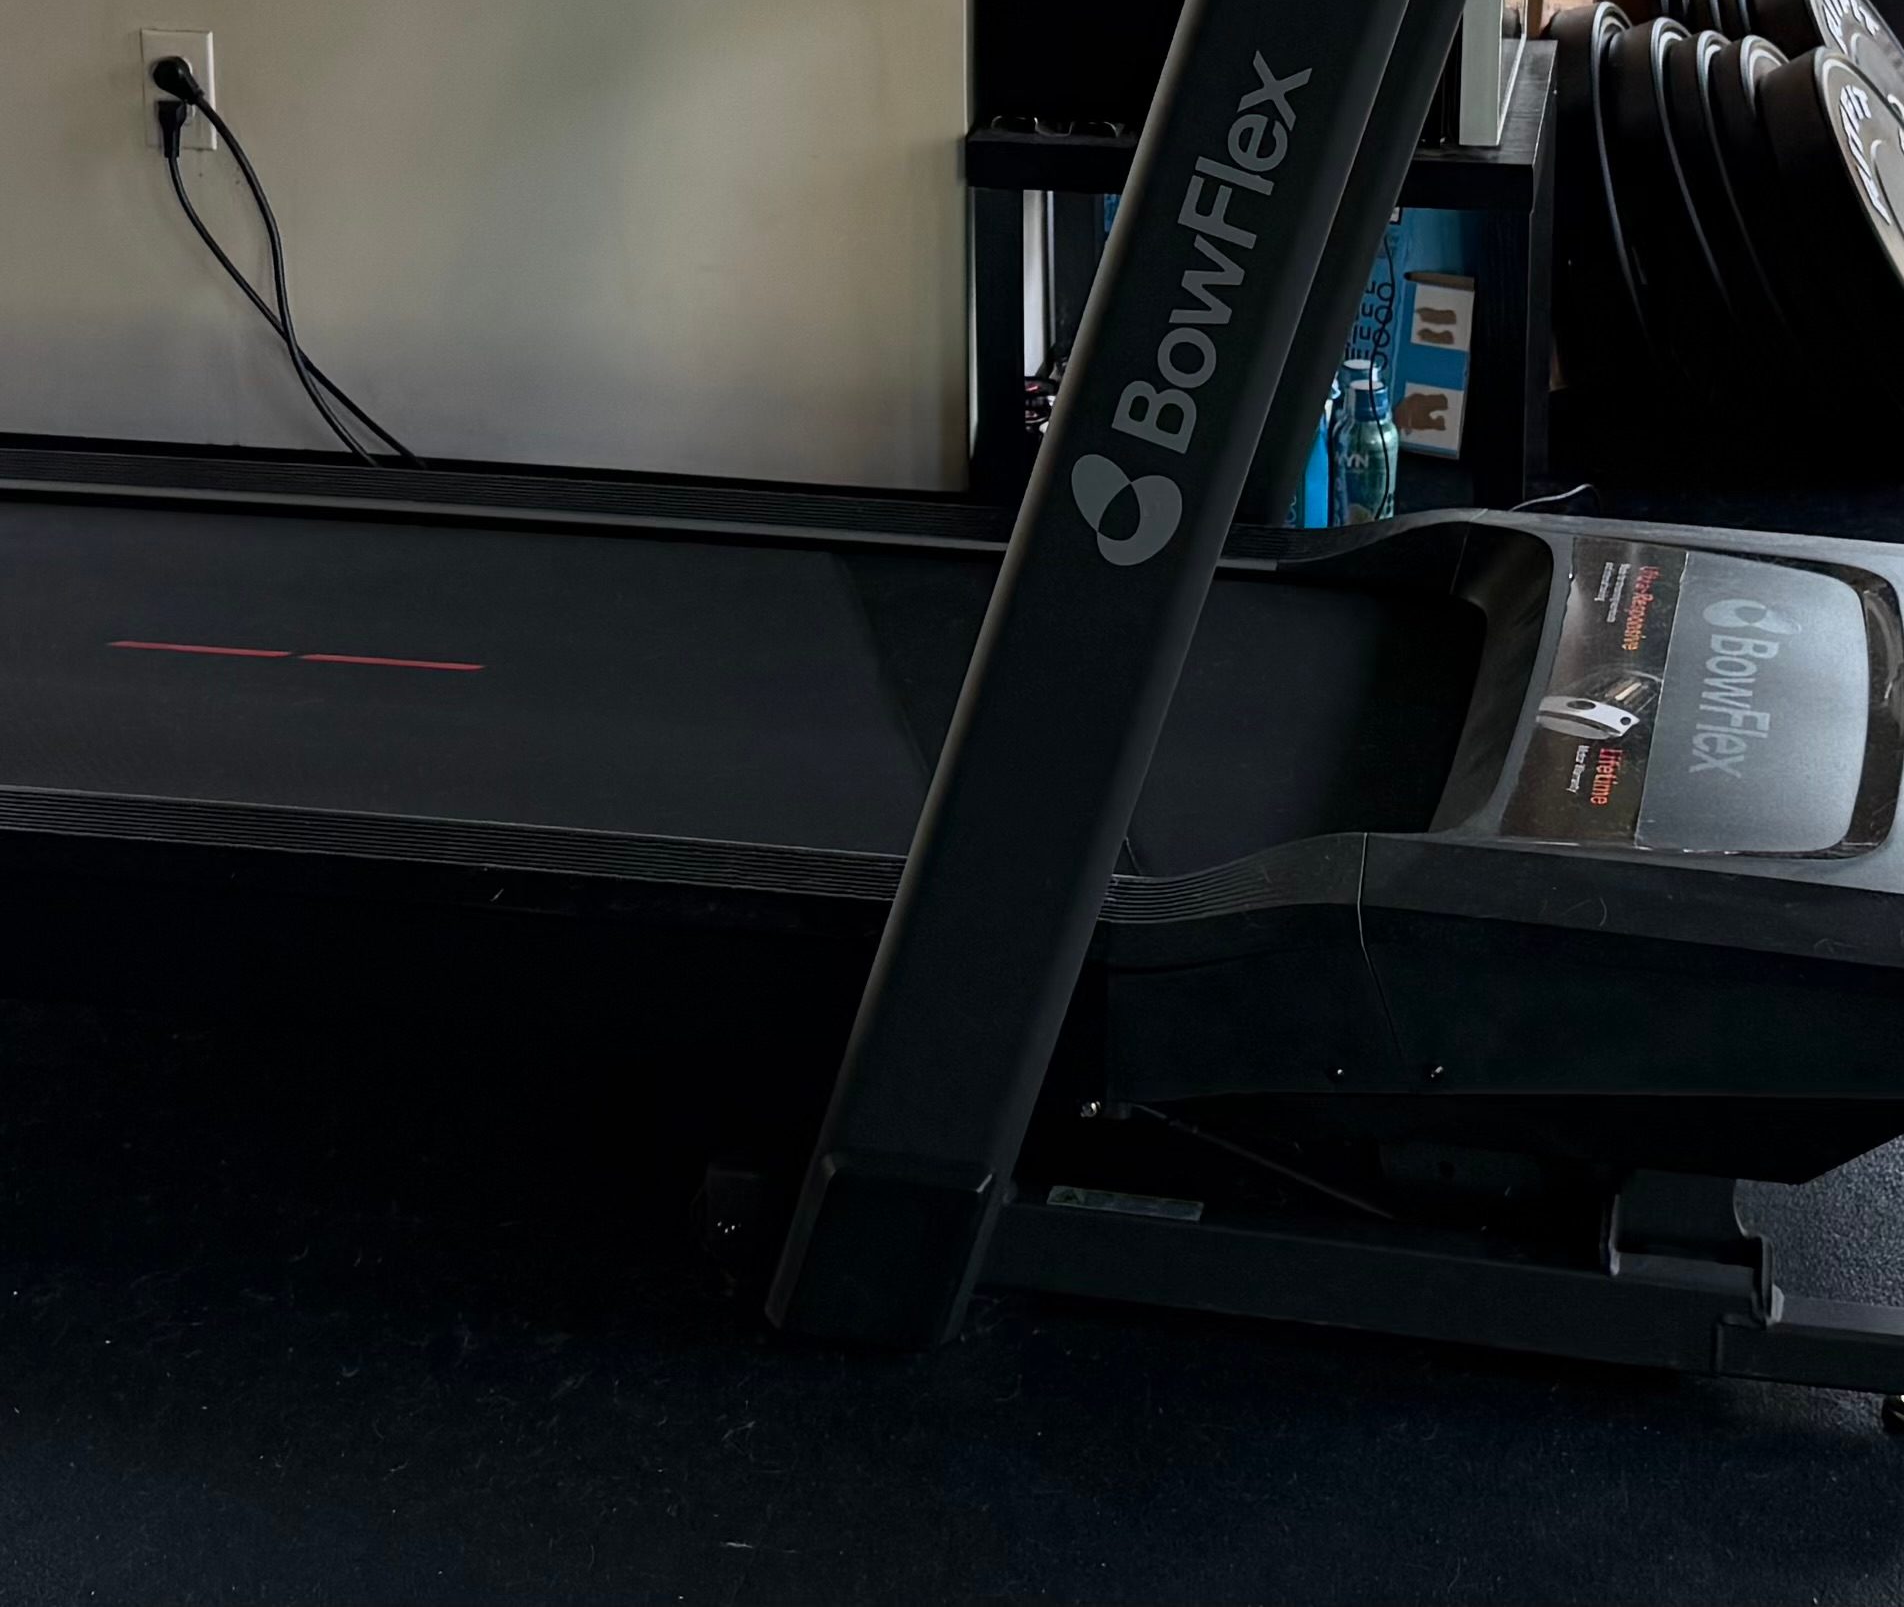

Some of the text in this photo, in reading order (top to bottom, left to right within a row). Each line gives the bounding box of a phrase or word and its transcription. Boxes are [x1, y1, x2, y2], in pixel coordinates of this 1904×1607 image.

[1111, 50, 1312, 454] BowFlex
[1590, 747, 1624, 807] Lifetime
[1688, 629, 1780, 781] BowFlex
